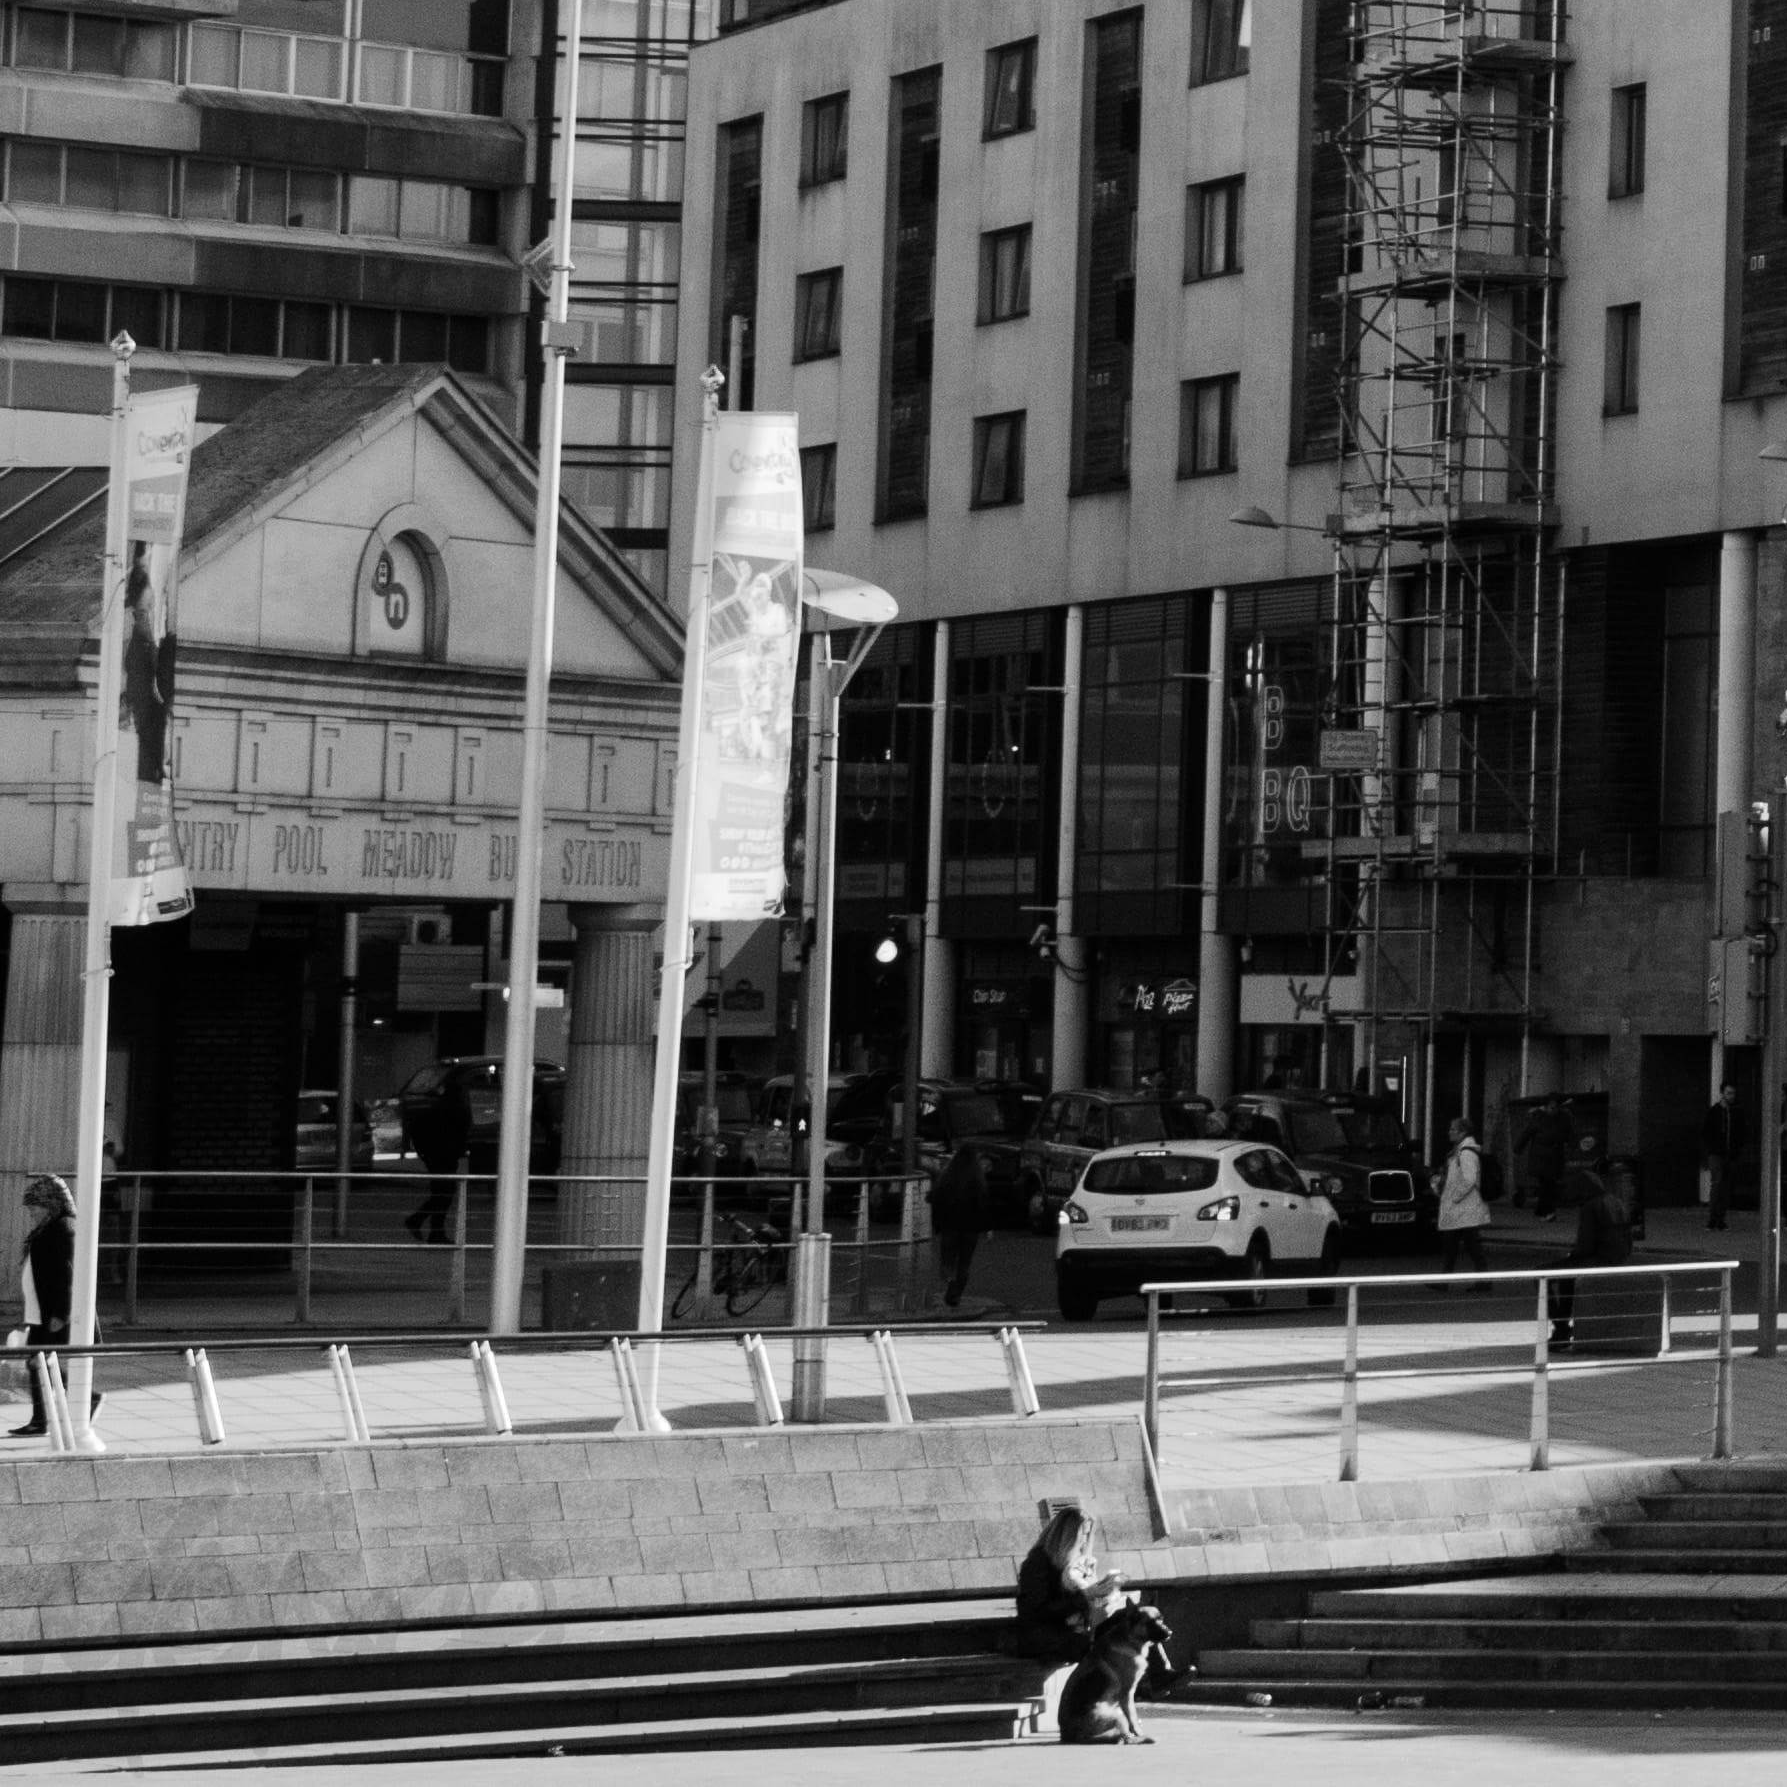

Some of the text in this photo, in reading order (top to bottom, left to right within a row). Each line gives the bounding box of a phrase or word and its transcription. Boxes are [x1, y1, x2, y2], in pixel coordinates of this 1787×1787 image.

[272, 824, 328, 877] POOL
[362, 828, 458, 882] MEADOW
[488, 833, 518, 883] BU
[561, 837, 642, 888] STATION
